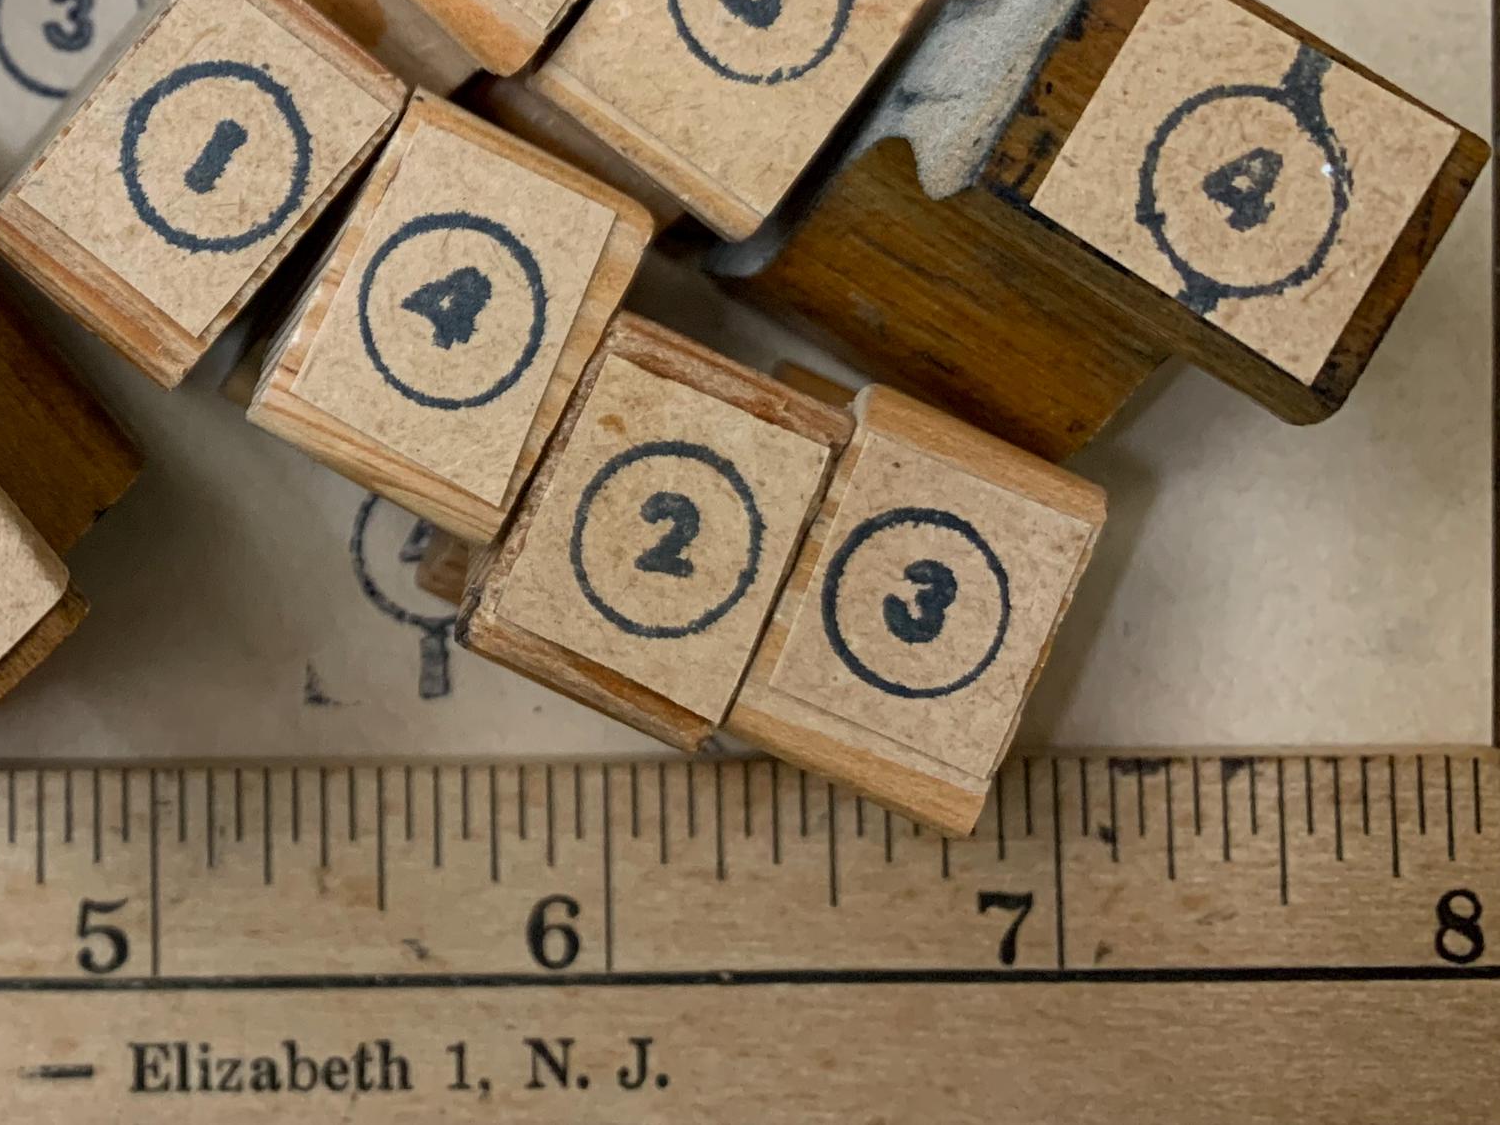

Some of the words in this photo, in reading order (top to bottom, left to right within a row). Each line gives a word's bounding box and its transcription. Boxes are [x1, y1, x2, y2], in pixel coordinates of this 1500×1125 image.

[183, 119, 249, 195] 1
[1201, 146, 1284, 233] 4
[400, 266, 493, 351] 4
[634, 491, 701, 579] 2
[882, 559, 958, 646] 3
[76, 899, 129, 974] 5
[526, 895, 582, 971] 6
[977, 891, 1034, 966] 7
[1434, 888, 1486, 965] 8
[129, 1039, 413, 1093] Elizabeth
[446, 1041, 491, 1099] 1,
[524, 1038, 590, 1090] N.
[616, 1037, 670, 1091] J.
